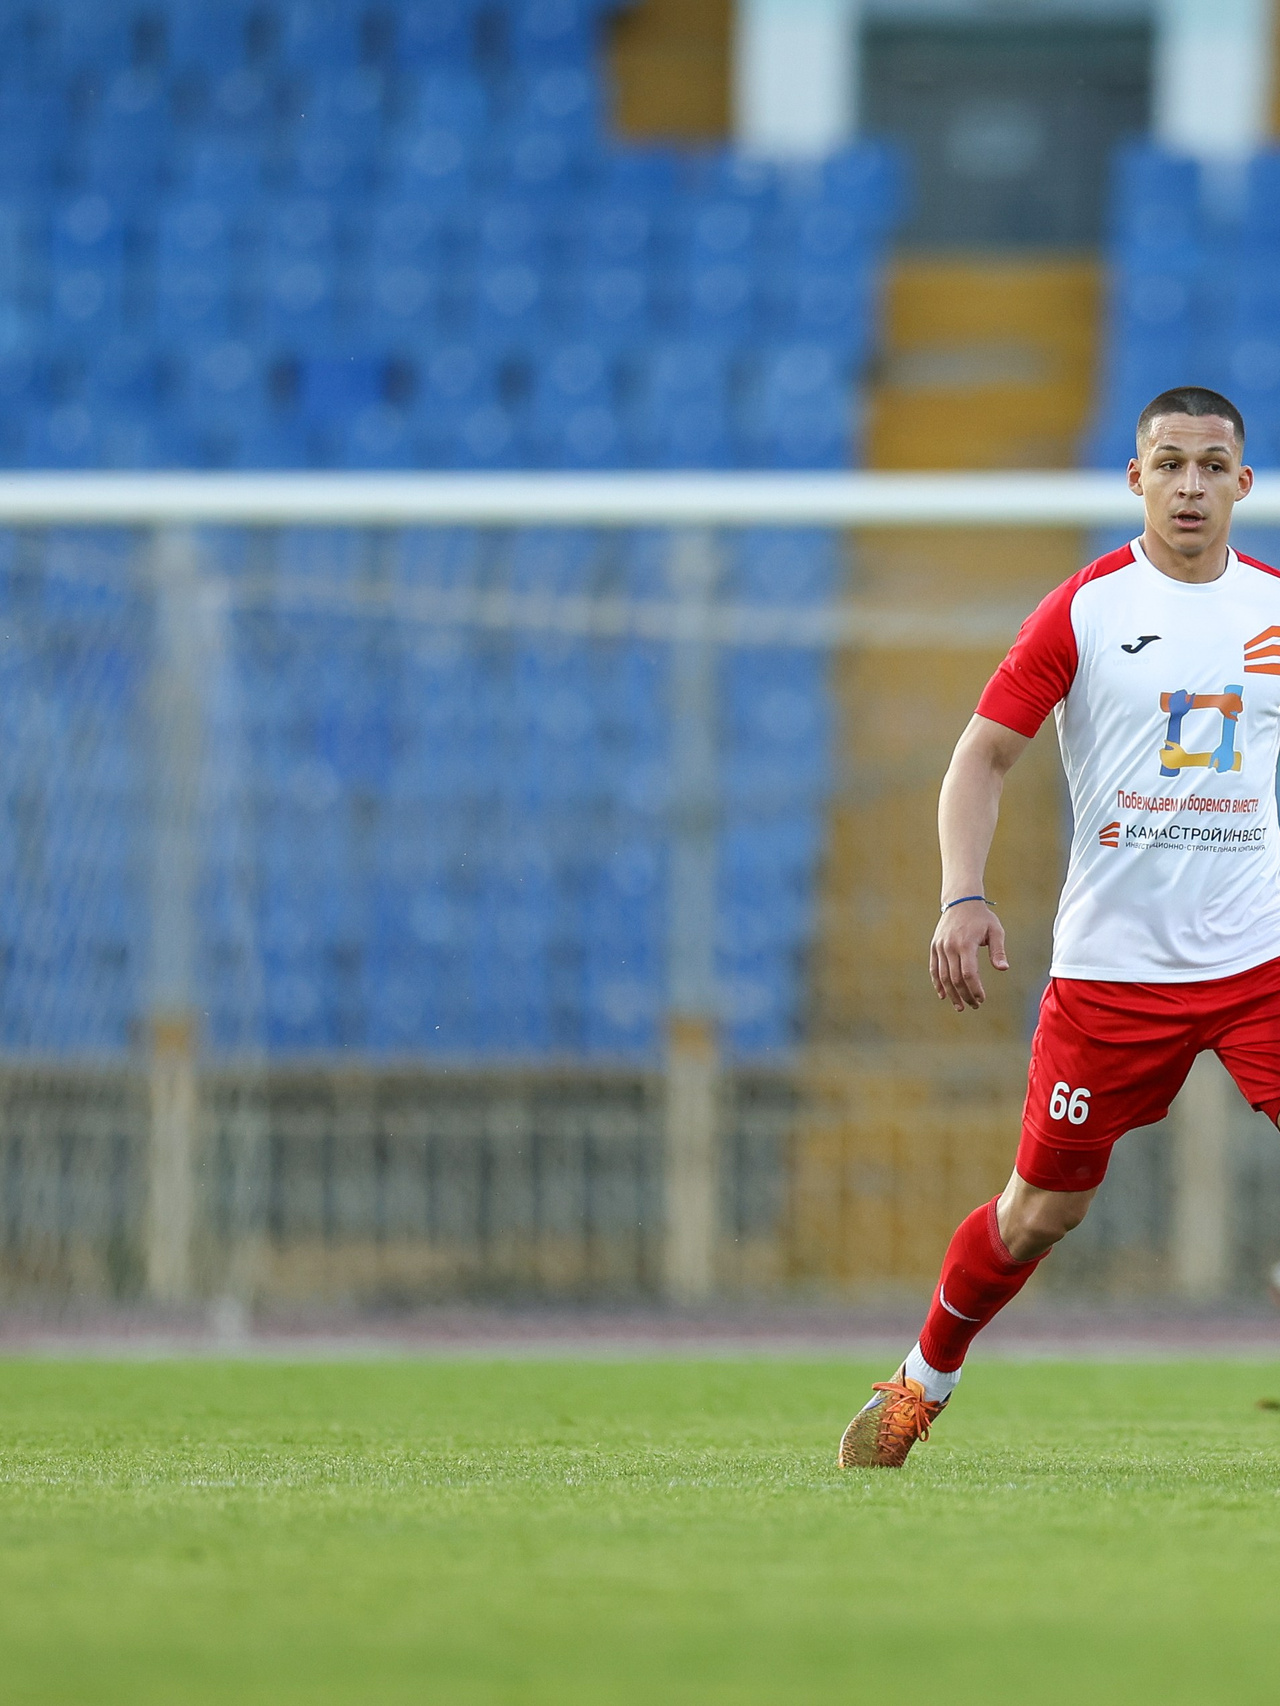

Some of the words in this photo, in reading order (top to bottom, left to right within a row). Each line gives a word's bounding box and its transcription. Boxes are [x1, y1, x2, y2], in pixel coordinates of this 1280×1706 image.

[1117, 789, 1179, 814] Побеждаем
[1179, 797, 1187, 812] и
[1187, 793, 1231, 815] боремся
[1049, 1081, 1092, 1125] 66
